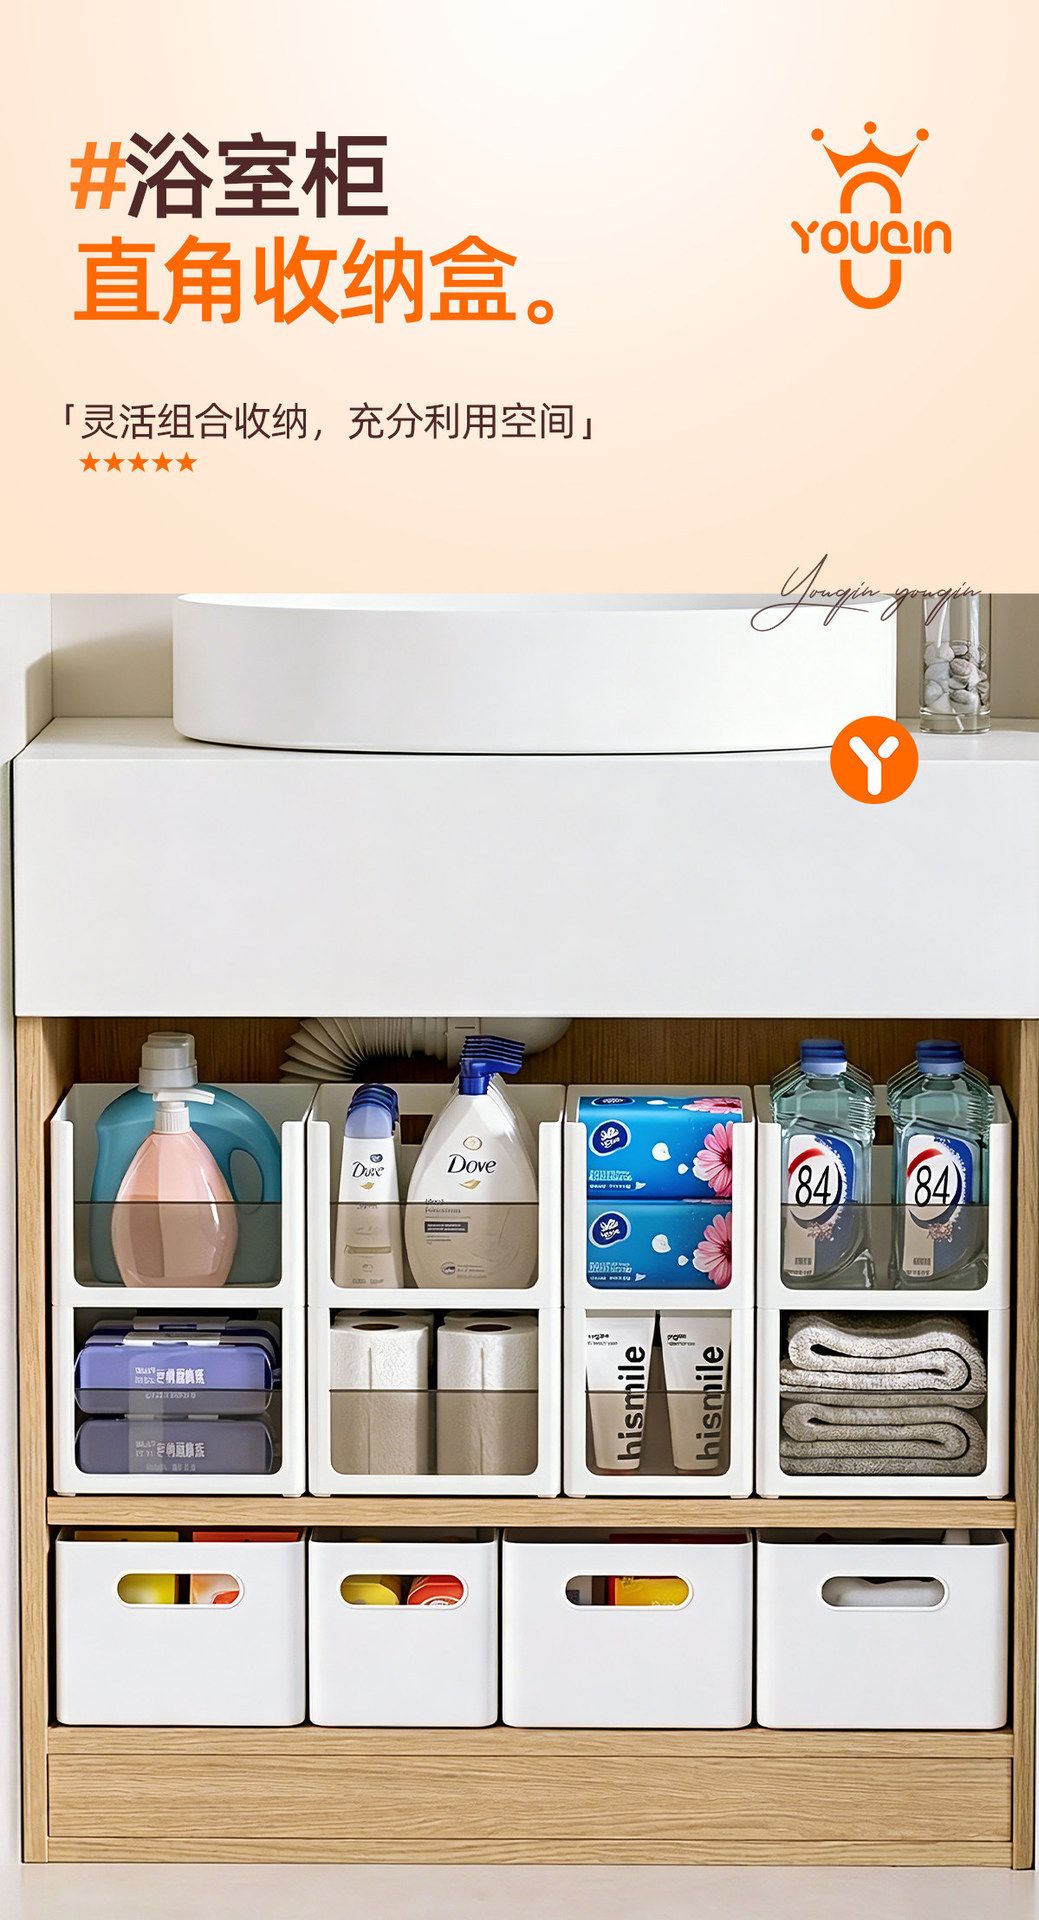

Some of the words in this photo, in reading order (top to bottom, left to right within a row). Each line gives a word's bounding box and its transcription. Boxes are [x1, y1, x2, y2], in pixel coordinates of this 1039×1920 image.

[447, 1153, 497, 1174] Dove
[795, 1164, 832, 1207] 84
[914, 1164, 950, 1207] 84
[617, 1346, 646, 1461] hismile
[695, 1346, 724, 1461] hismile
